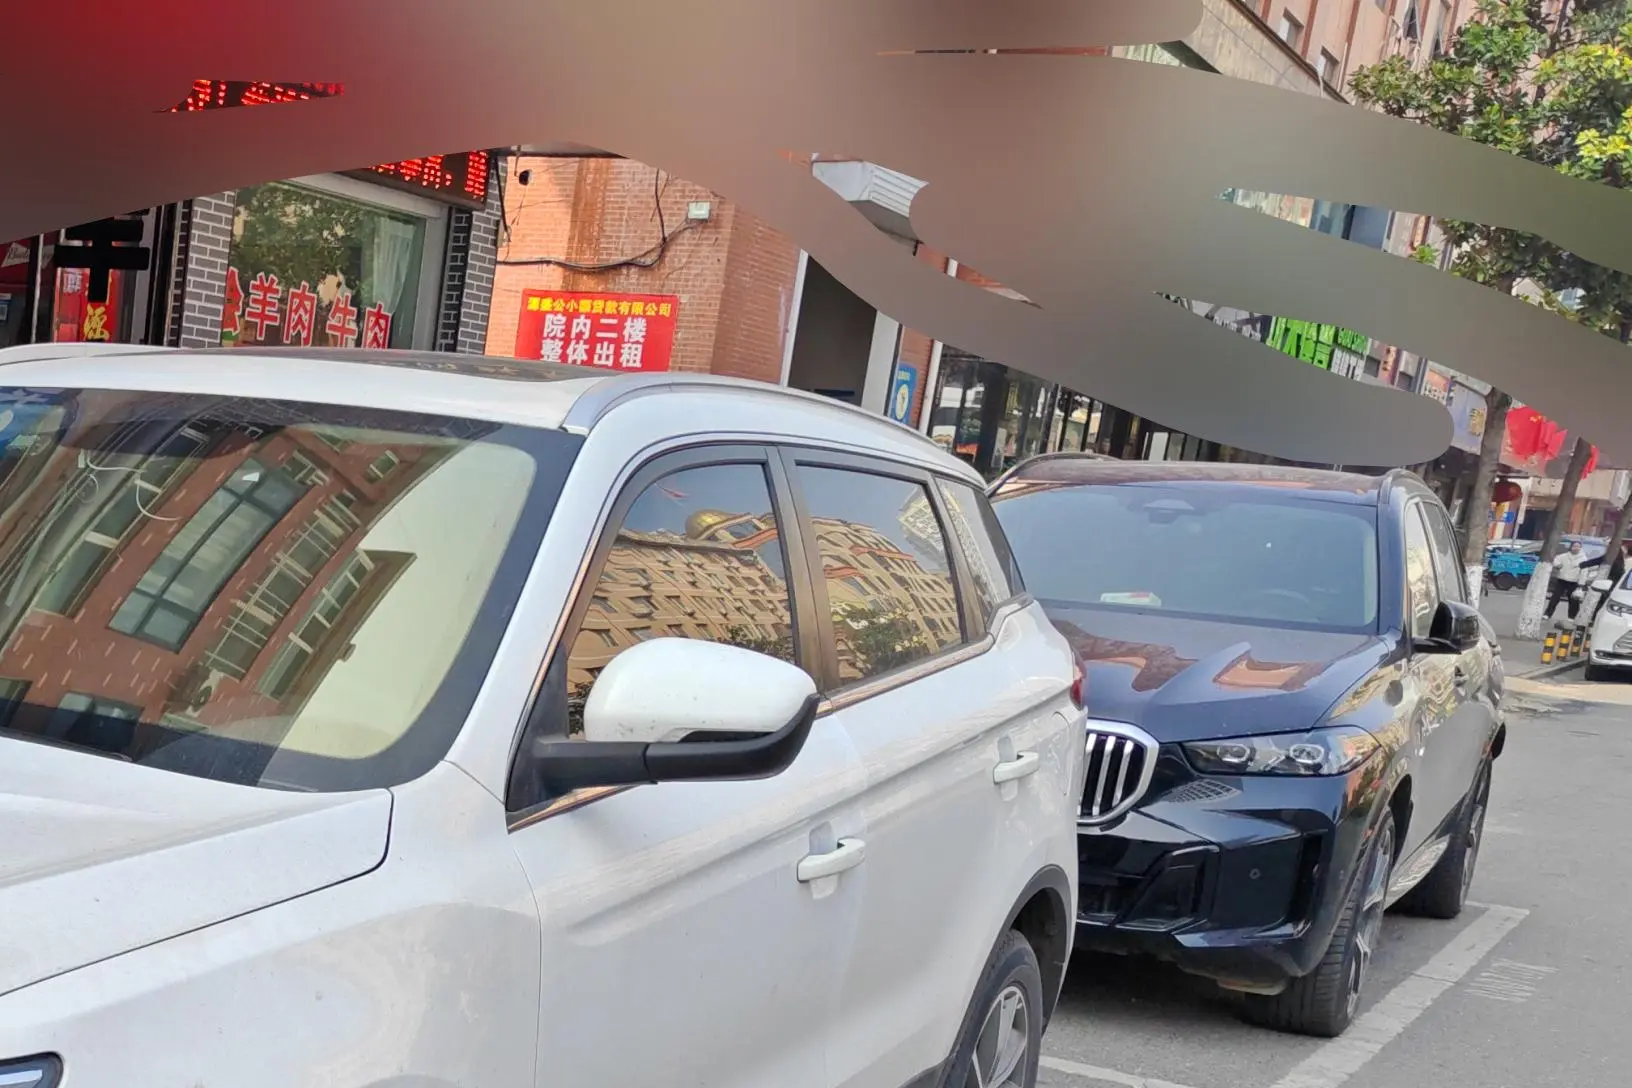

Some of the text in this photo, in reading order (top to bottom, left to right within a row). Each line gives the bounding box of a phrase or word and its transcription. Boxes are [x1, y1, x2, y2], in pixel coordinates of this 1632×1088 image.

[543, 313, 648, 342] 院内二楼
[540, 339, 643, 368] 整体出租
